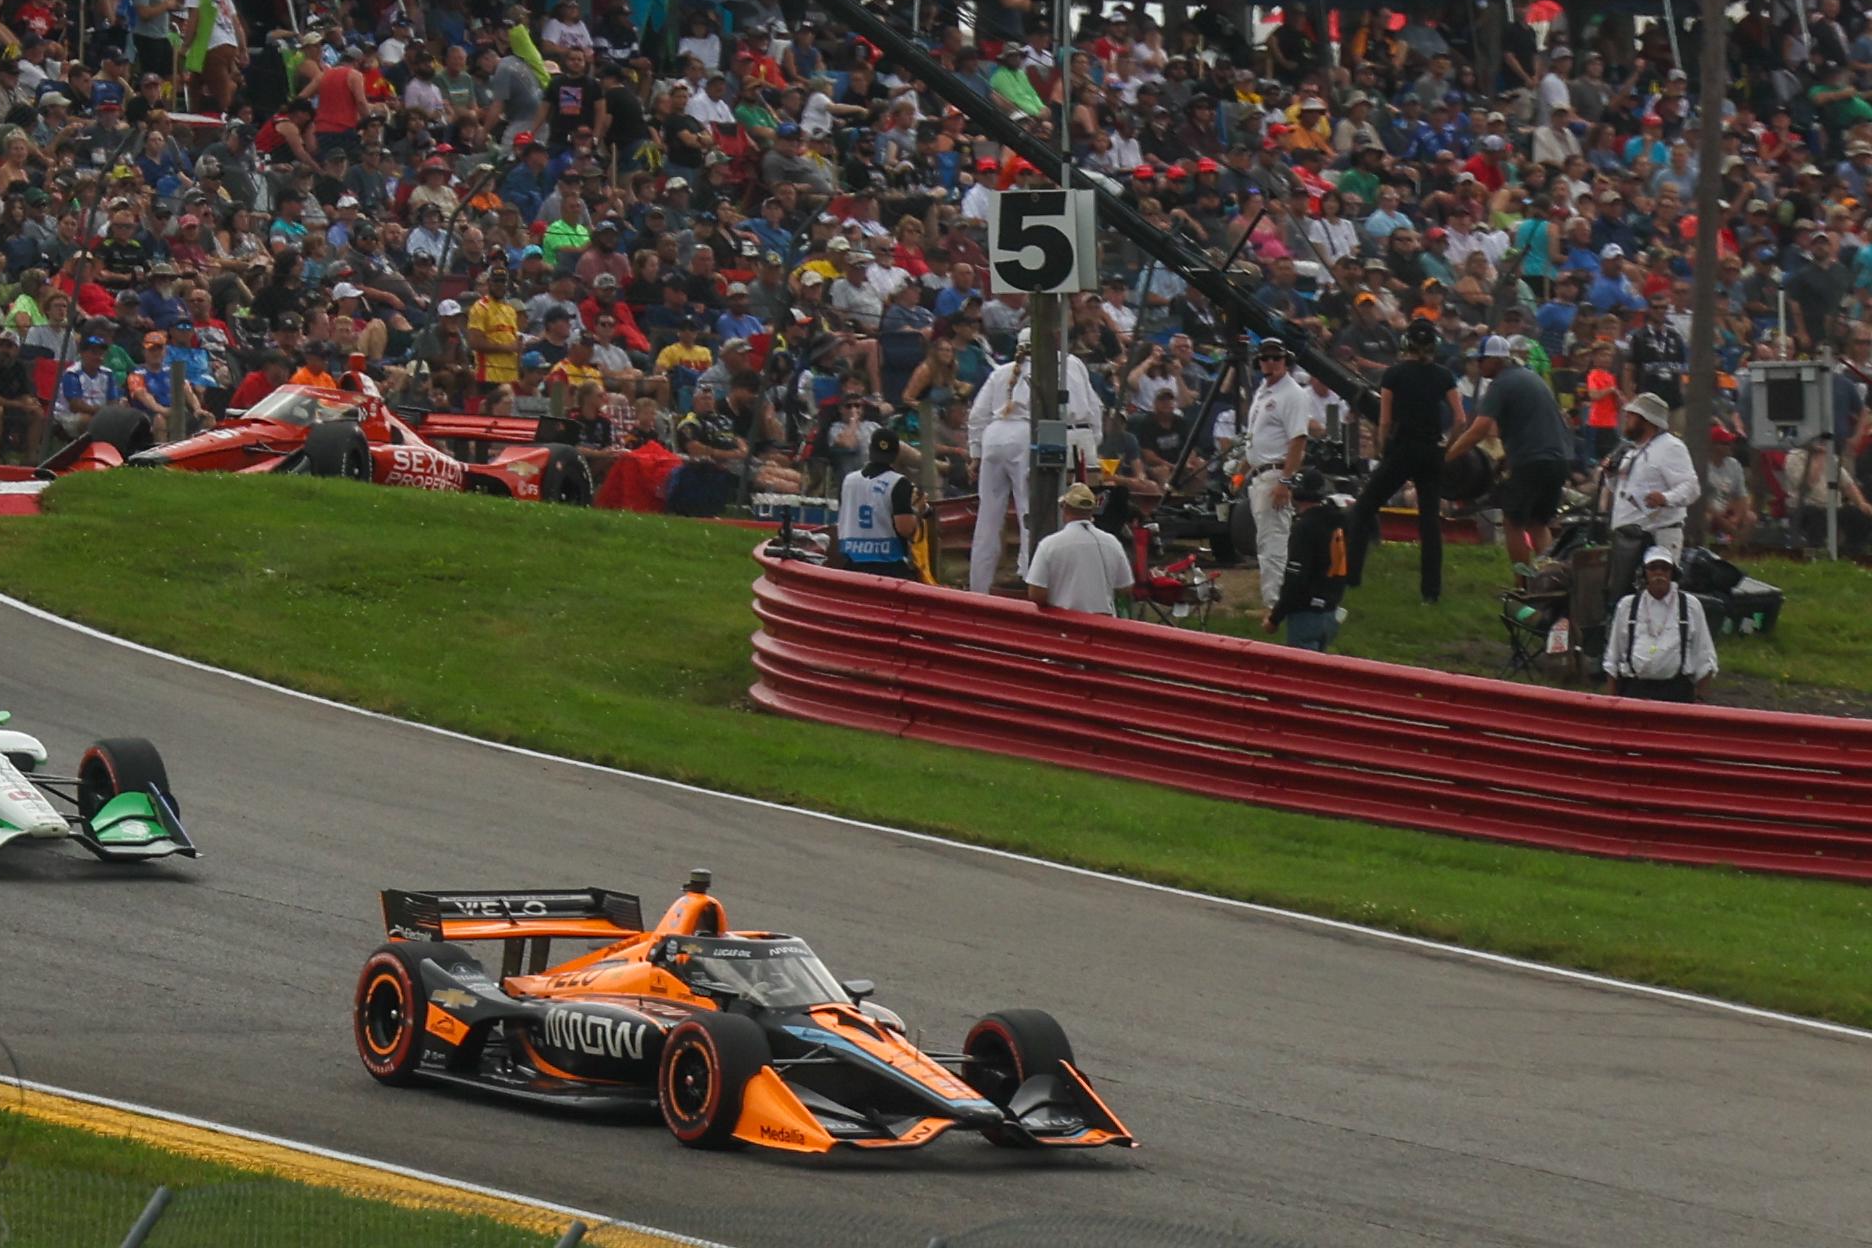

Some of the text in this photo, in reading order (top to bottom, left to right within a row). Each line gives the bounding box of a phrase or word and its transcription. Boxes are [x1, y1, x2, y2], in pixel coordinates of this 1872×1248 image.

[994, 191, 1074, 292] 5
[393, 450, 464, 485] SEXTON
[859, 504, 873, 529] 9
[845, 540, 890, 555] PHOTO
[454, 900, 548, 917] VELO
[759, 1124, 806, 1146] Medallia
